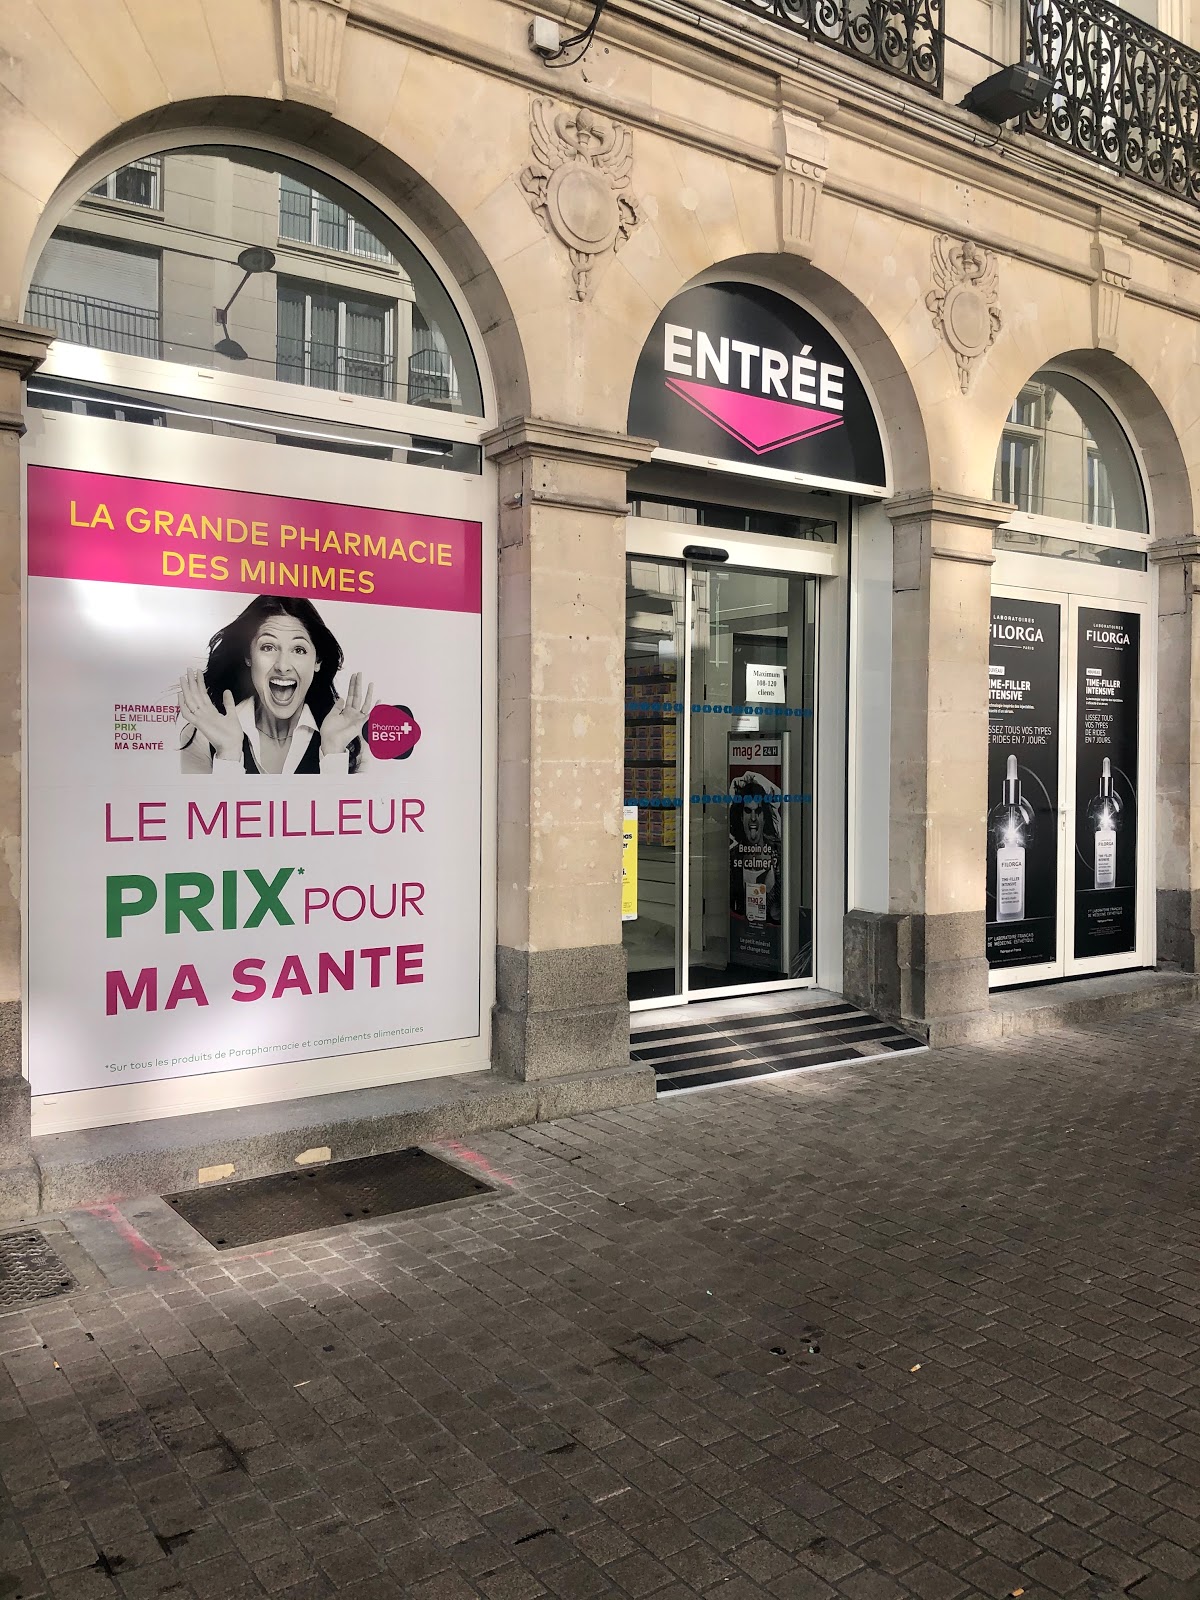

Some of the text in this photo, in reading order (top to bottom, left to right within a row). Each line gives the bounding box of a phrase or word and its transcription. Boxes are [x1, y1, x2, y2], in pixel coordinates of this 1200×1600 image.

[664, 322, 844, 411] ENTRÉE
[69, 500, 453, 567] LA GRANDE PHARMACIE
[161, 551, 375, 594] DES MINIMES
[993, 614, 1035, 624] LABORATOIRES
[1086, 630, 1130, 645] FILORGA
[753, 670, 780, 678] Maximum
[989, 679, 1031, 690] IME-FILLER
[1086, 678, 1120, 688] TIME-FILLER
[989, 690, 1022, 700] TENSIVE
[1086, 687, 1114, 695] INTENSIVE
[114, 704, 180, 713] PHARMABEST
[129, 714, 176, 722] MEILLEUR
[372, 723, 400, 731] Pharma
[988, 725, 1051, 735] SSEZ TOUS VOS TYPES
[993, 735, 1010, 744] RIDES
[1012, 736, 1020, 744] EN
[114, 741, 164, 750] MA SANTÉ
[732, 746, 753, 760] mag
[754, 744, 761, 756] 2
[105, 798, 426, 843] LE MEILLEUR
[739, 844, 771, 853] Besoin de
[733, 859, 742, 867] se
[744, 857, 771, 868] calmer
[304, 882, 426, 925] POUR
[105, 943, 424, 1017] MA SANTE
[130, 1061, 152, 1070] tous
[155, 1058, 169, 1067] les
[171, 1053, 212, 1066] produits
[214, 1050, 227, 1059] de
[229, 1041, 299, 1057] Parapharmacie
[302, 1040, 311, 1048] et
[313, 1032, 371, 1046] compléments
[373, 1025, 424, 1038] alimentaires
